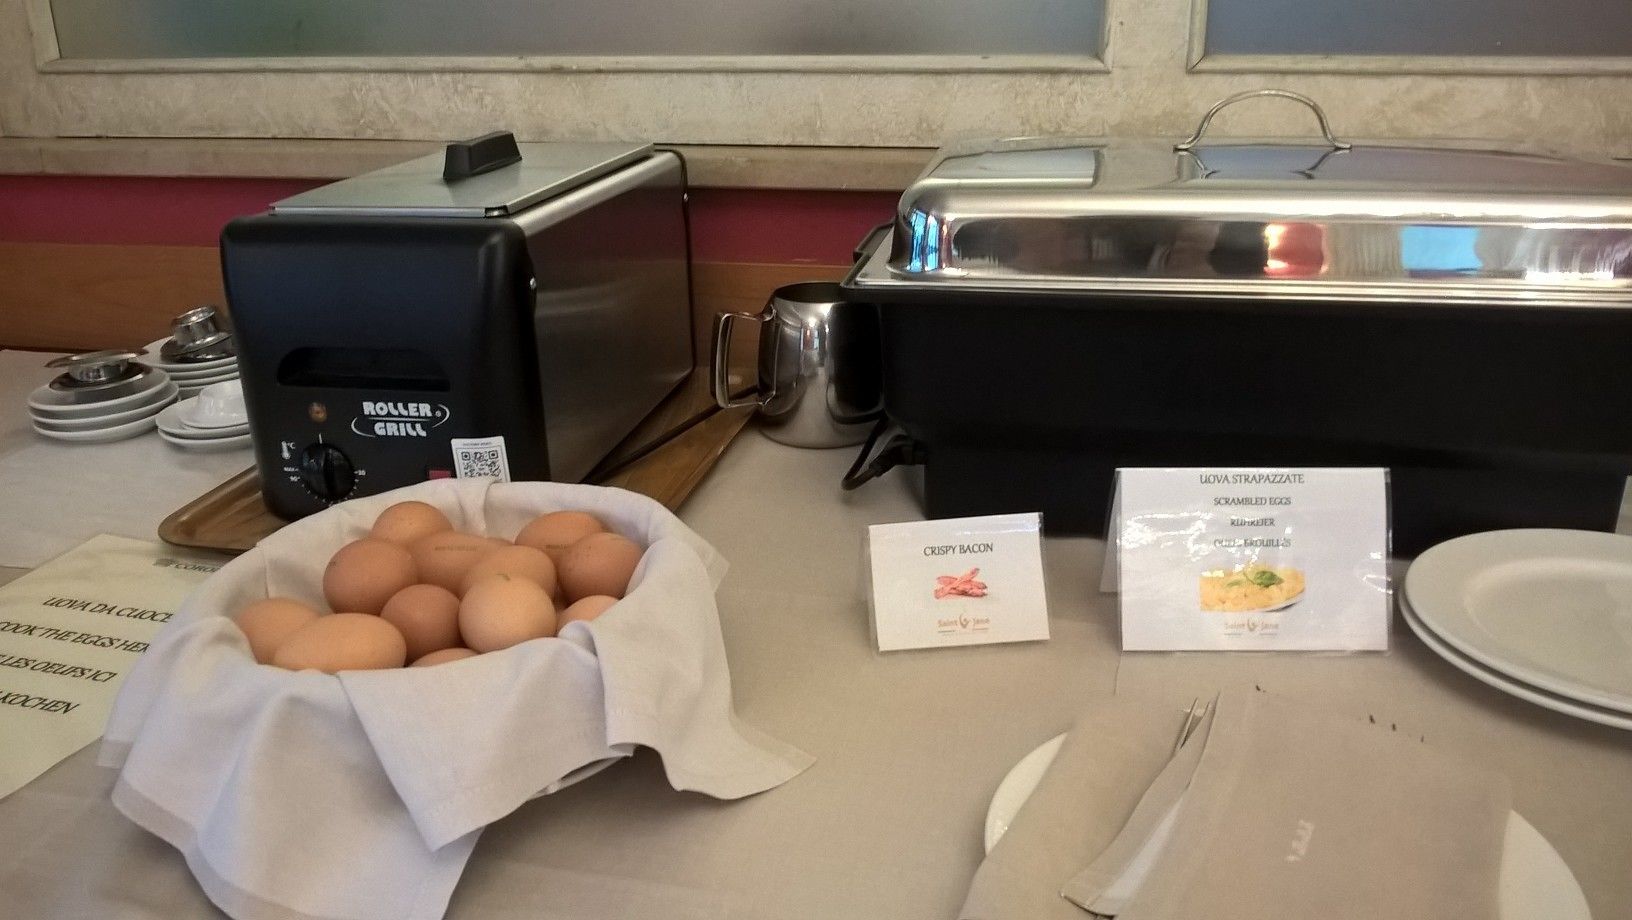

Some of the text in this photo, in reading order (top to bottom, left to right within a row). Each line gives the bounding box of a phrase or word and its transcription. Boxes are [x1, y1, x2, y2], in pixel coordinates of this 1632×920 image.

[362, 401, 433, 418] ROLLER
[373, 421, 427, 437] GRILL
[1199, 473, 1305, 485] UOVA STRAPAZZATE
[1213, 496, 1292, 506] SCRAMBLED EGGS
[923, 543, 993, 557] CRISPY BACON
[42, 596, 88, 612] UOVA
[89, 602, 113, 616] DA
[37, 626, 78, 641] THE
[71, 632, 119, 648] EGGS
[0, 656, 119, 683] LES OEUFS ICI
[0, 692, 81, 715] KOCHEN
